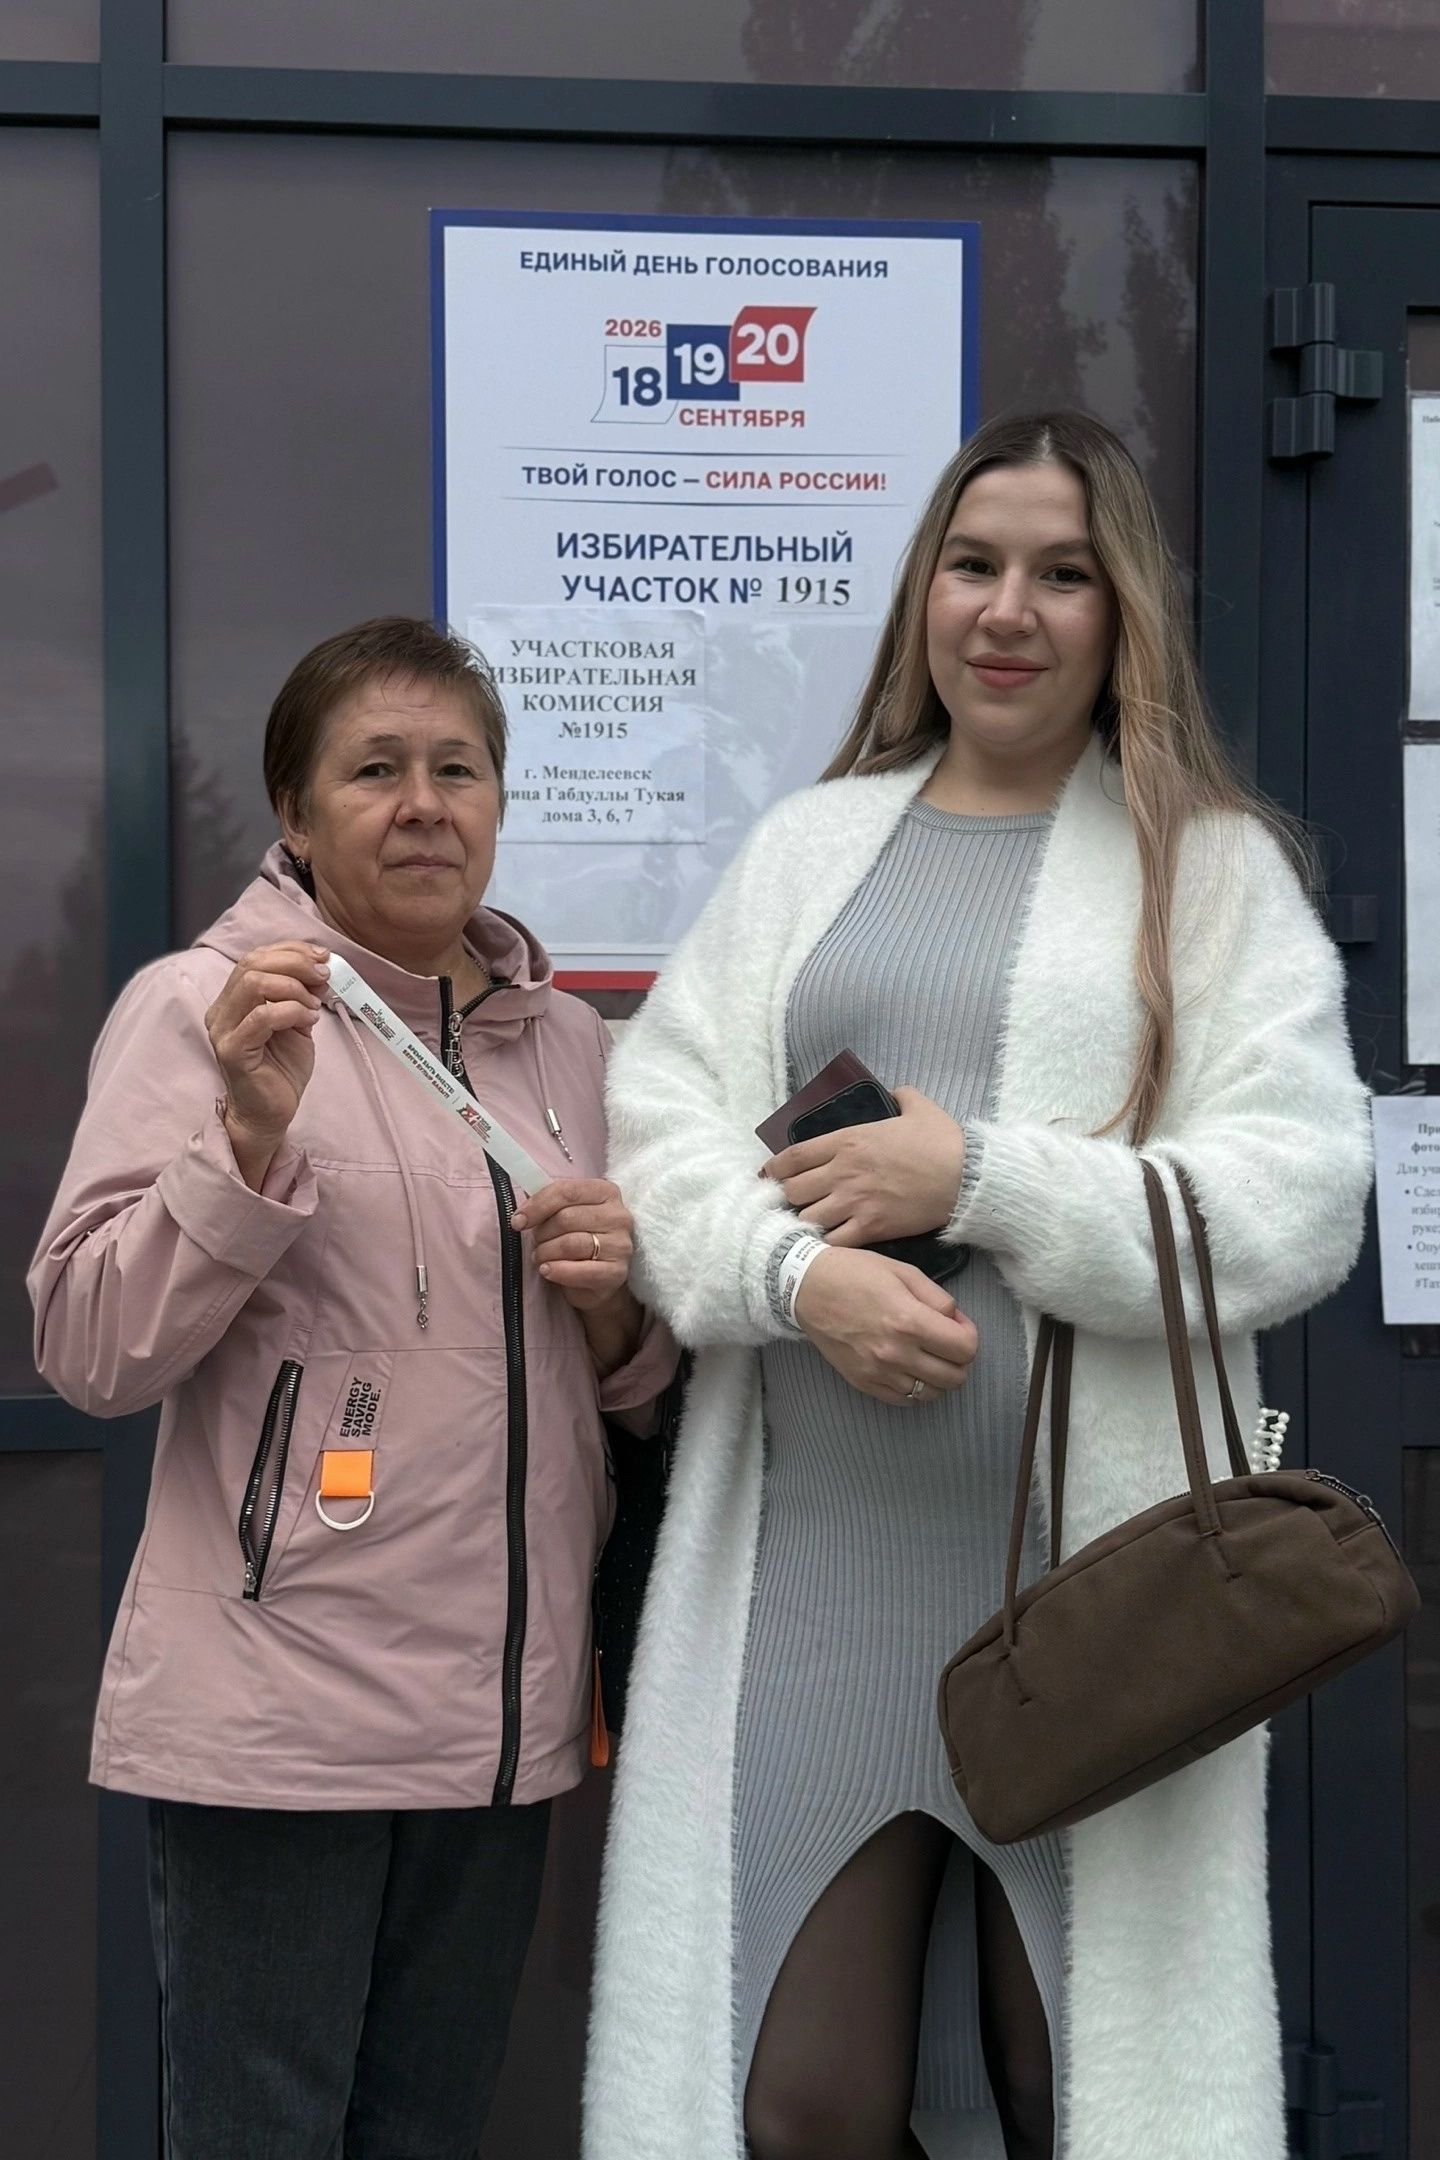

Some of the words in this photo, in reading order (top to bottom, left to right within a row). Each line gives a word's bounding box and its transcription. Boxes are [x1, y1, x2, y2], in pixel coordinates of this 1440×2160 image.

[520, 250, 627, 273] ЕДИНЫЙ
[633, 255, 698, 276] ДЕНЬ
[705, 257, 889, 278] ГОЛОСОВАНИЯ
[605, 319, 662, 337] 2026
[612, 366, 662, 407] 18
[673, 343, 725, 385] 19
[736, 323, 799, 366] 20
[679, 408, 805, 428] СЕНТЯБРЯ
[522, 464, 588, 486] ТВОЙ
[595, 468, 677, 489] ГОЛОС
[705, 470, 773, 491] СИЛА
[780, 472, 886, 491] РОССИИ!
[556, 530, 853, 562] ИЗБИРАТЕЛЬНЫЙ
[561, 574, 720, 603] УЧАСТОК
[729, 577, 762, 604] №
[775, 576, 851, 606] 1915
[510, 640, 675, 659] УЧАСТКОВАЯ
[490, 666, 697, 686] ИЗБИРАТЕЛЬНАЯ
[522, 694, 664, 713] КОМИССИЯ
[558, 722, 628, 739] №1915
[524, 768, 537, 779] г.
[542, 765, 652, 780] Менделеевск
[546, 787, 629, 804] Габдуллы
[634, 788, 685, 804] Тукая
[542, 812, 583, 823] дома
[587, 809, 601, 824] 3,
[606, 809, 620, 824] 6,
[624, 809, 634, 822] 7
[339, 1377, 362, 1437] ENERGY
[351, 1382, 372, 1437] SAVING
[362, 1389, 382, 1436] MODE.
